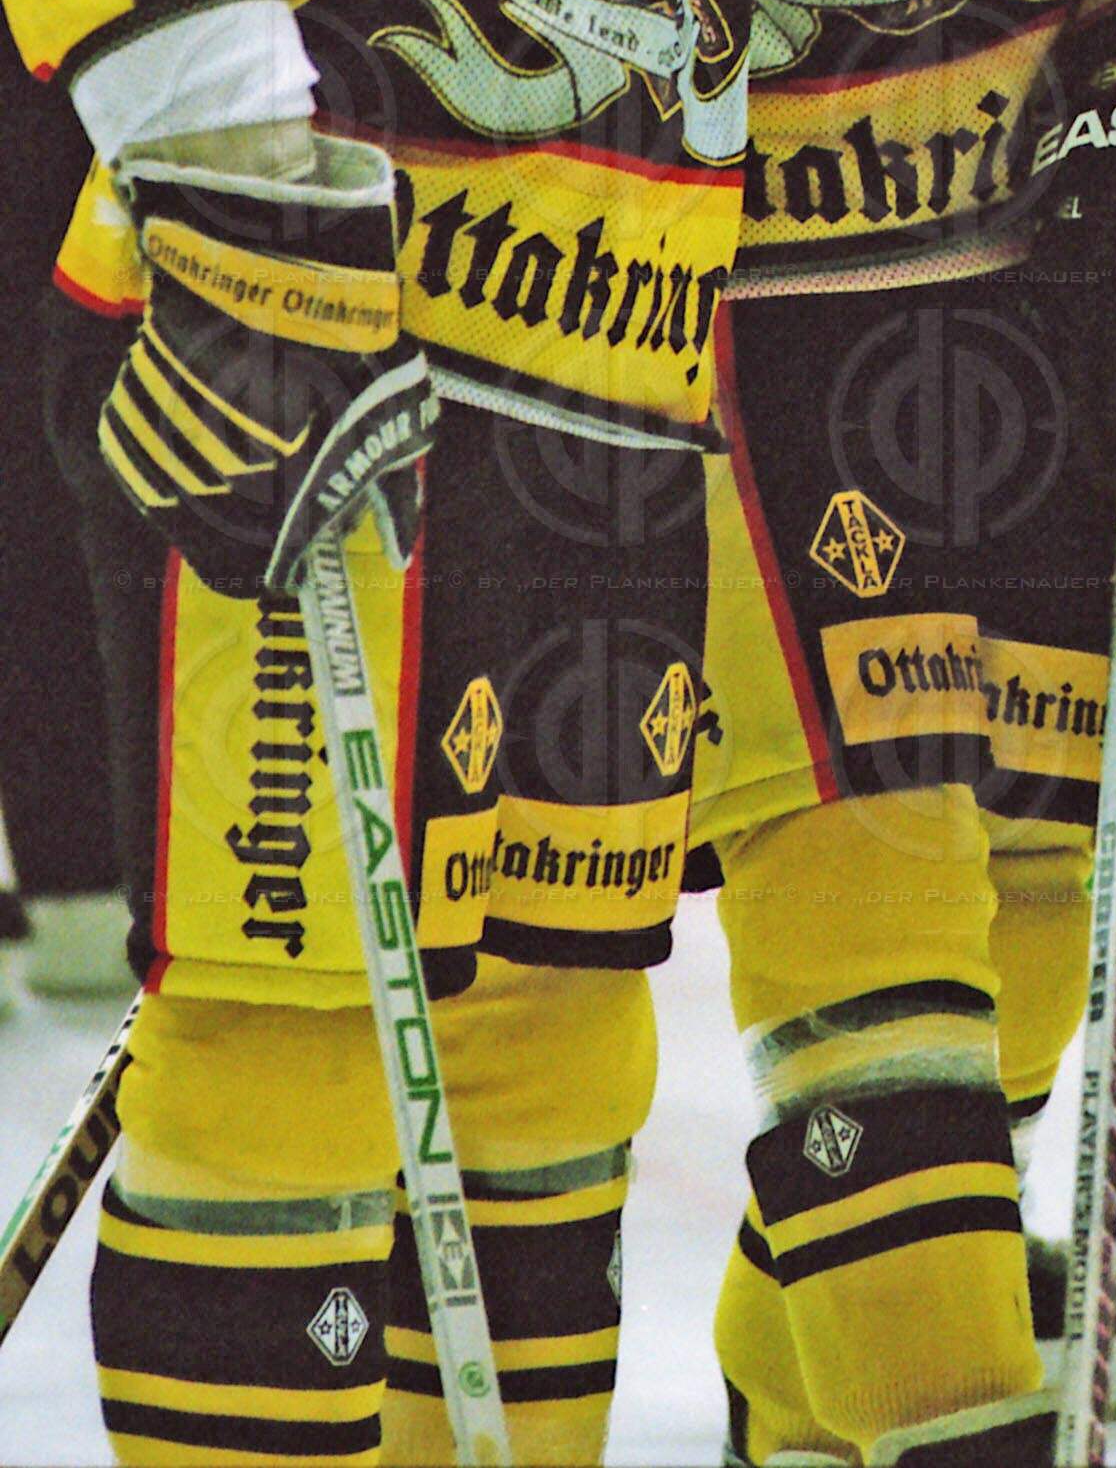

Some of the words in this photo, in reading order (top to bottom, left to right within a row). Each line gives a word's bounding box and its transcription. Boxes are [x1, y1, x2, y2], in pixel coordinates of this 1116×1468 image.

[149, 233, 274, 308] Ottakringer
[842, 499, 880, 588] TACKLA
[340, 729, 453, 1165] EASTON
